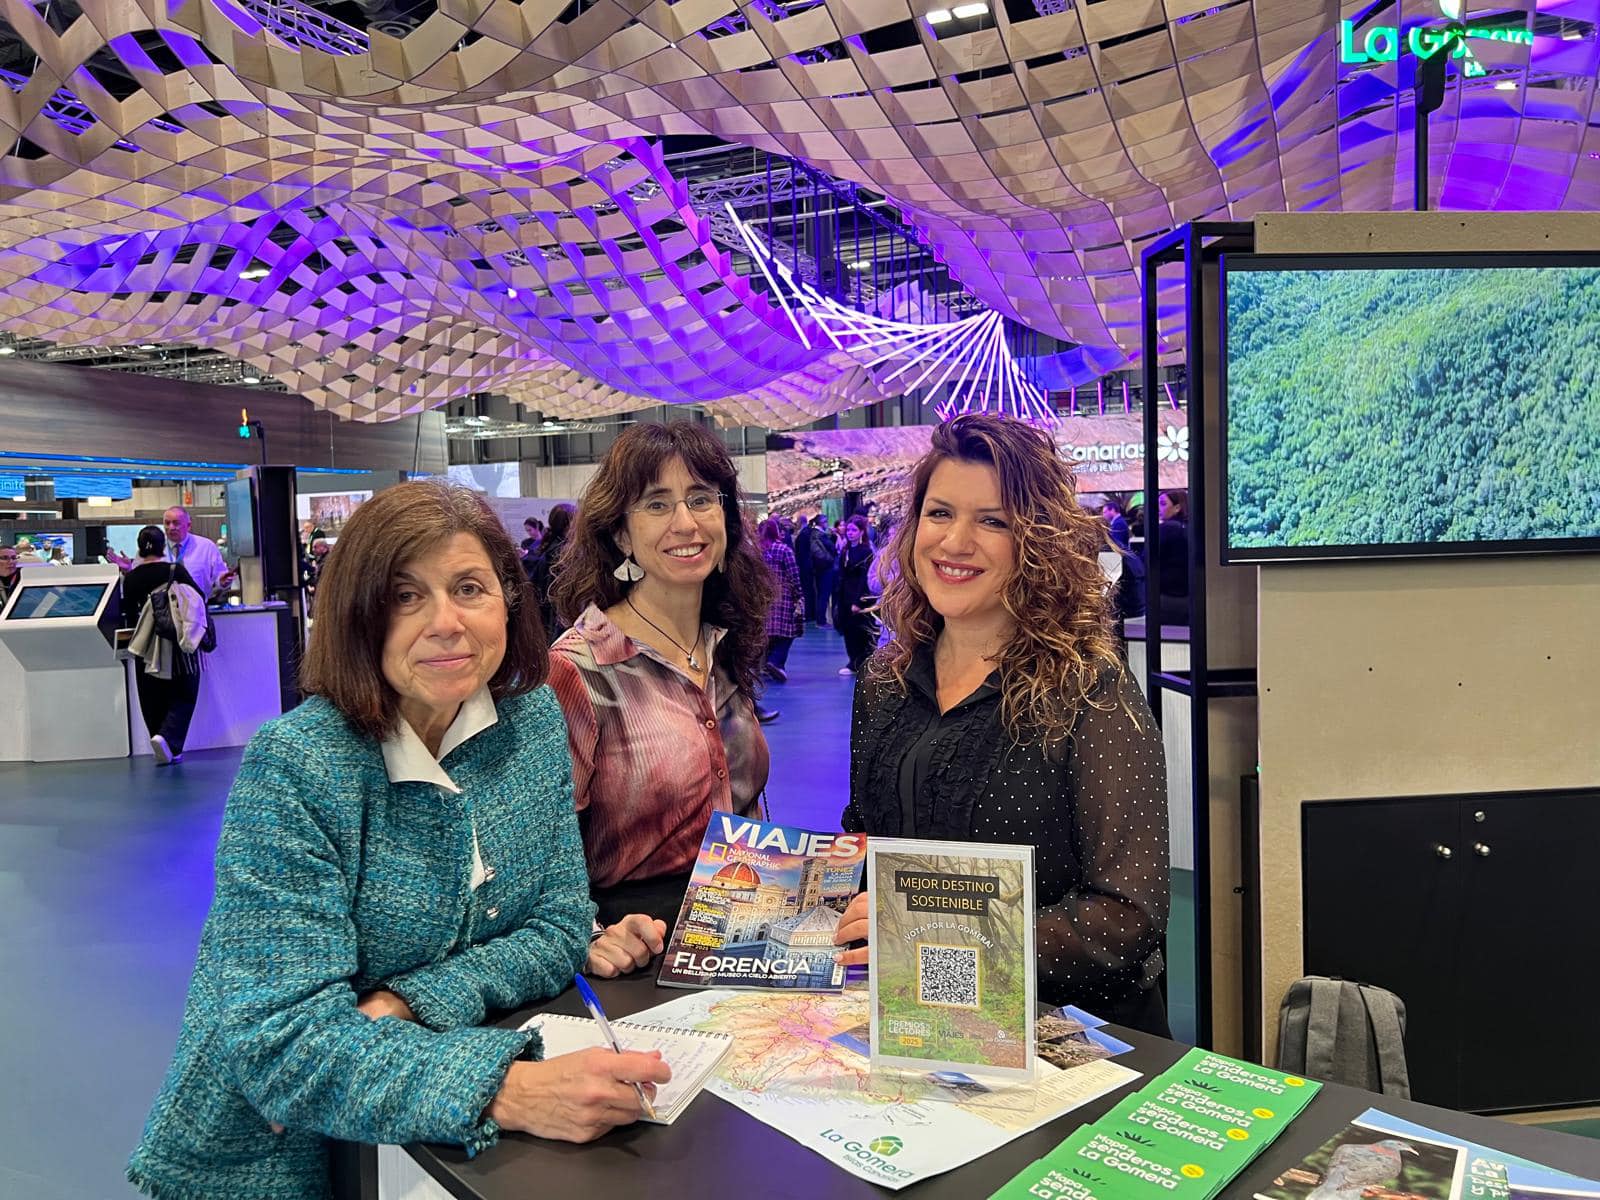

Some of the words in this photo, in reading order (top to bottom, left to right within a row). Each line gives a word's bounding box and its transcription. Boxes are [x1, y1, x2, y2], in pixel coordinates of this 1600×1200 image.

[1341, 20, 1399, 63] La
[721, 816, 860, 858] VIAJES
[726, 855, 782, 869] GEOGRAPHIC
[729, 848, 771, 861] NATIONAL
[900, 877, 939, 891] MEJOR
[942, 880, 995, 893] DESTINO
[911, 895, 984, 911] SOSTENIBLE
[926, 921, 944, 930] POR
[945, 921, 956, 929] LA
[957, 924, 994, 949] GOMERA!
[673, 951, 811, 974] FLORENCIA
[718, 971, 742, 979] MUSEO
[888, 1026, 931, 1037] LECTORES
[901, 1036, 920, 1046] 2025
[1204, 1055, 1236, 1067] Mapa
[1193, 1064, 1213, 1075] La
[1216, 1071, 1285, 1095] Gomera
[1200, 1060, 1277, 1085] senderos
[1170, 1082, 1202, 1096] Mapa
[1142, 1101, 1175, 1116] Mapa
[1156, 1093, 1178, 1104] La
[1180, 1100, 1252, 1128] Gomera
[1164, 1087, 1246, 1116] senderos
[1127, 1112, 1150, 1125] La
[1152, 1120, 1224, 1151] Gomera
[1136, 1107, 1218, 1138] senderos
[1094, 1133, 1128, 1151] Mapa
[820, 1128, 844, 1142] La
[843, 1141, 915, 1179] Gomera
[1087, 1140, 1173, 1176] senderos
[1077, 1146, 1101, 1160] La
[1103, 1156, 1179, 1190] Gomera
[1047, 1170, 1083, 1189] Mapa
[1028, 1183, 1054, 1199] La
